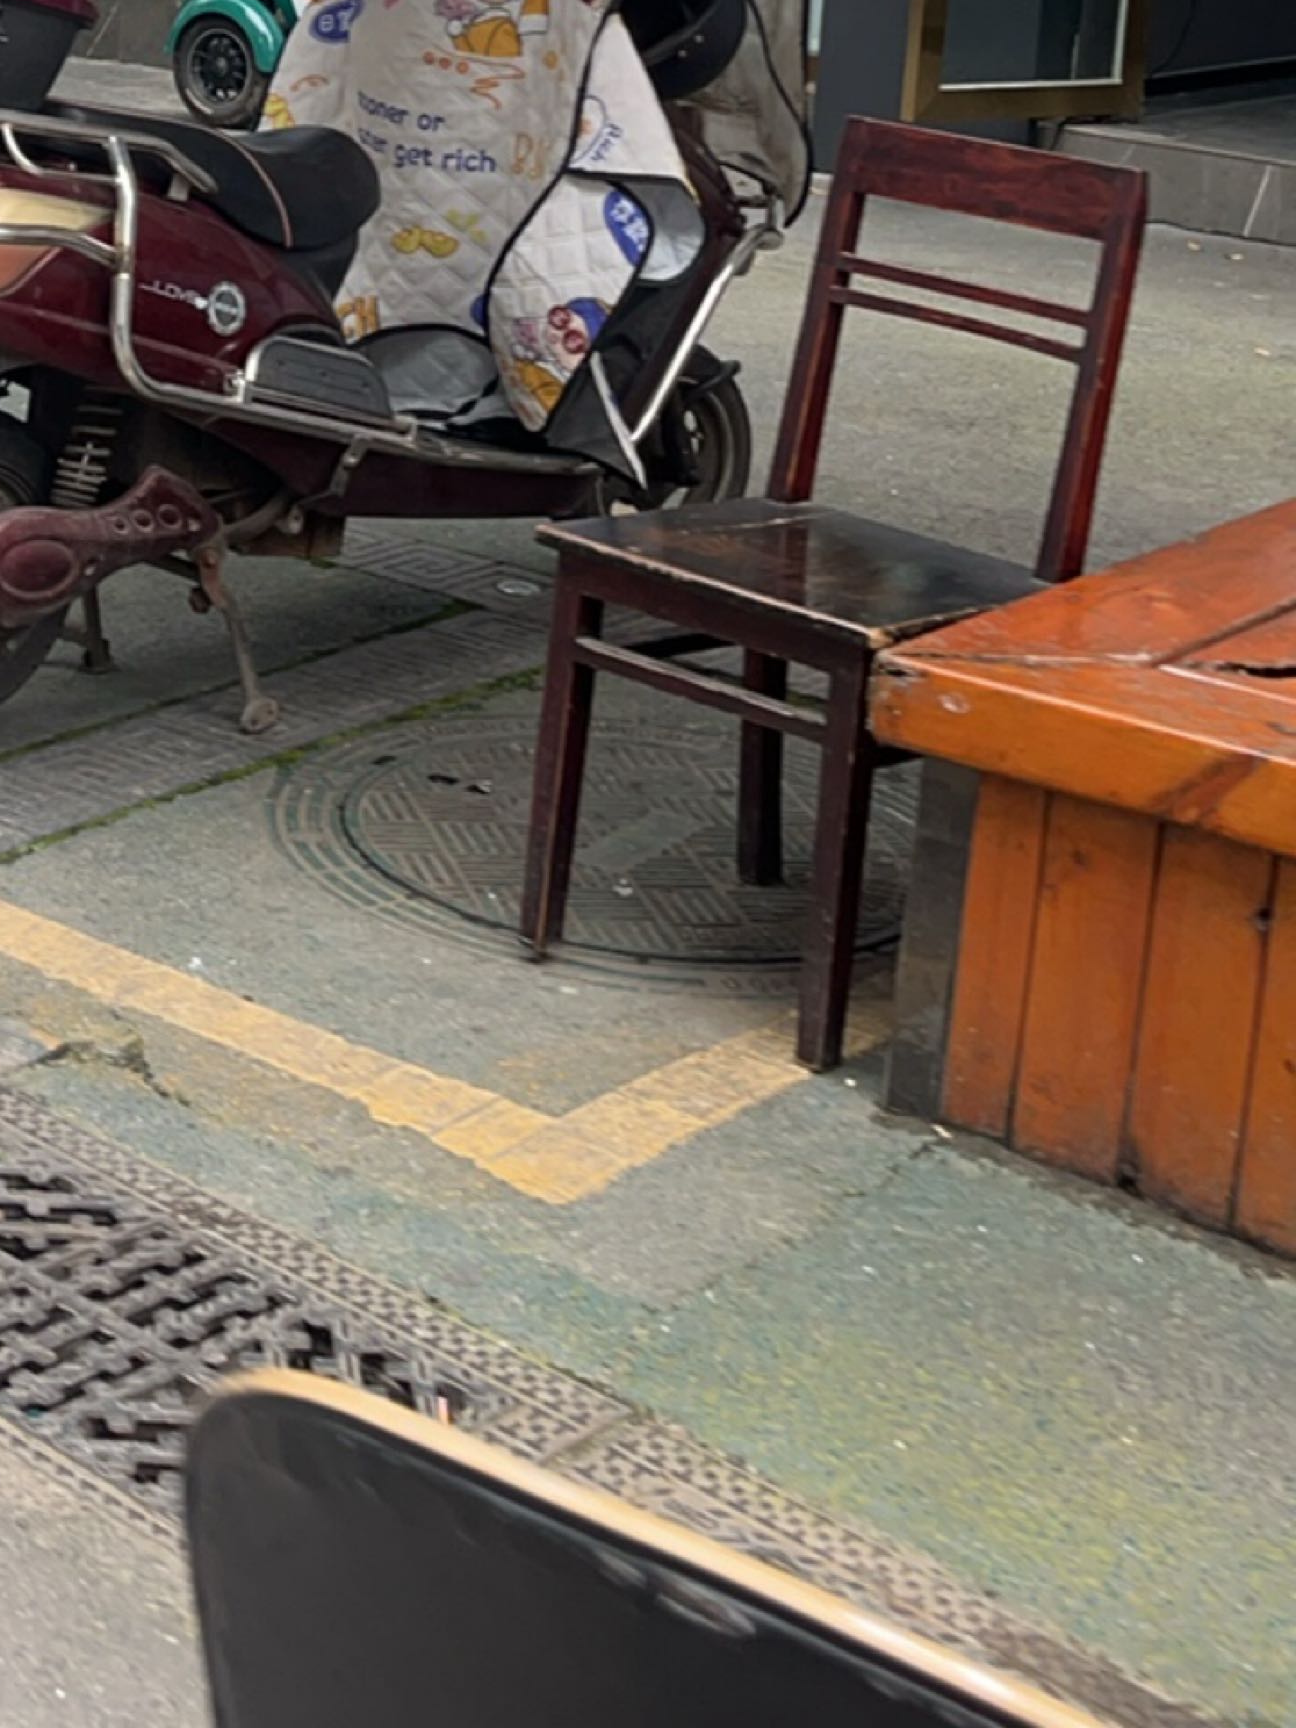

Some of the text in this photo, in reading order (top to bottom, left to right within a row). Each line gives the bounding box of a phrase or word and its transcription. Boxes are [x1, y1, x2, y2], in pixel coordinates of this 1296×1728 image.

[416, 112, 446, 131] or
[394, 143, 433, 168] get
[441, 148, 497, 172] rich
